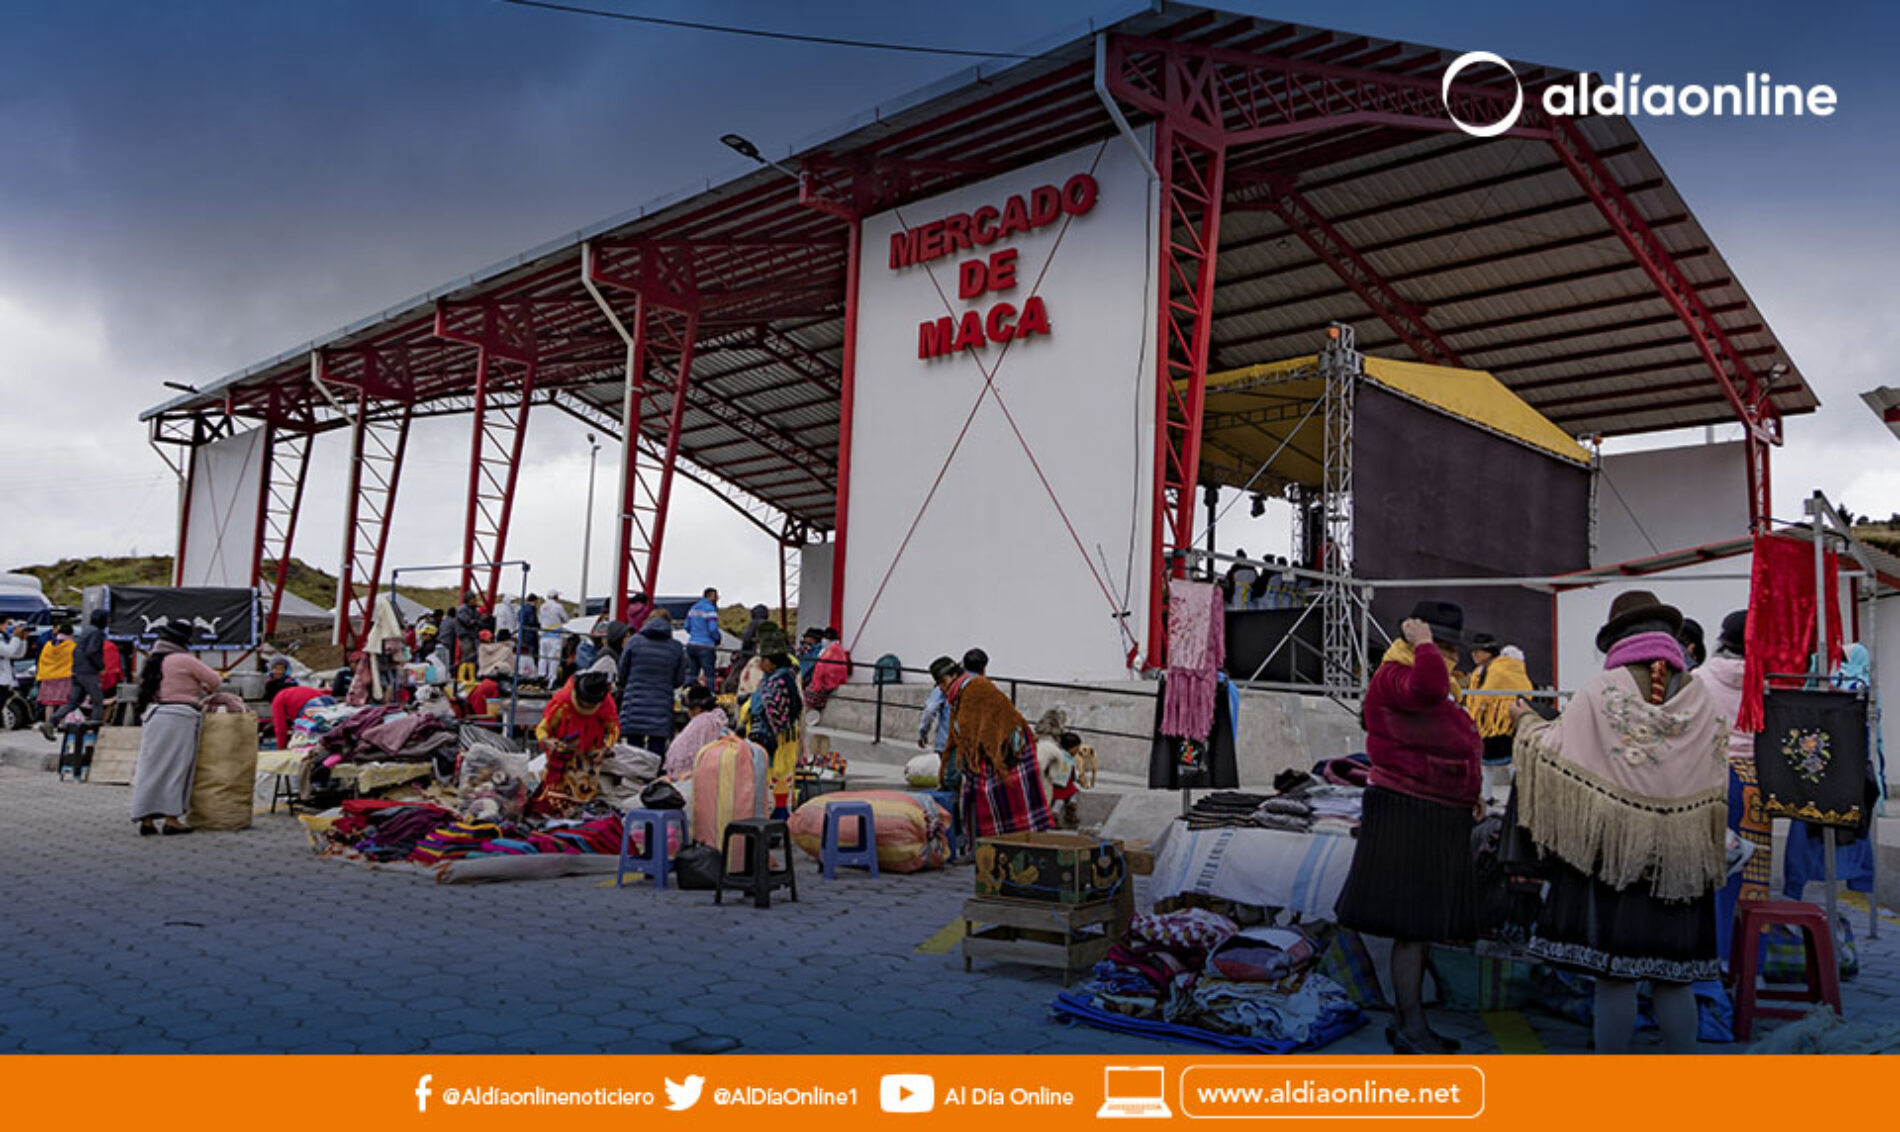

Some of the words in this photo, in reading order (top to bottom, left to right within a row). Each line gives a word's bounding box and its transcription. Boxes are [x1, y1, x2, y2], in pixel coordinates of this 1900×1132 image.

[889, 173, 1098, 270] MERCADO
[958, 248, 1018, 300] DE
[918, 296, 1050, 360] MACA
